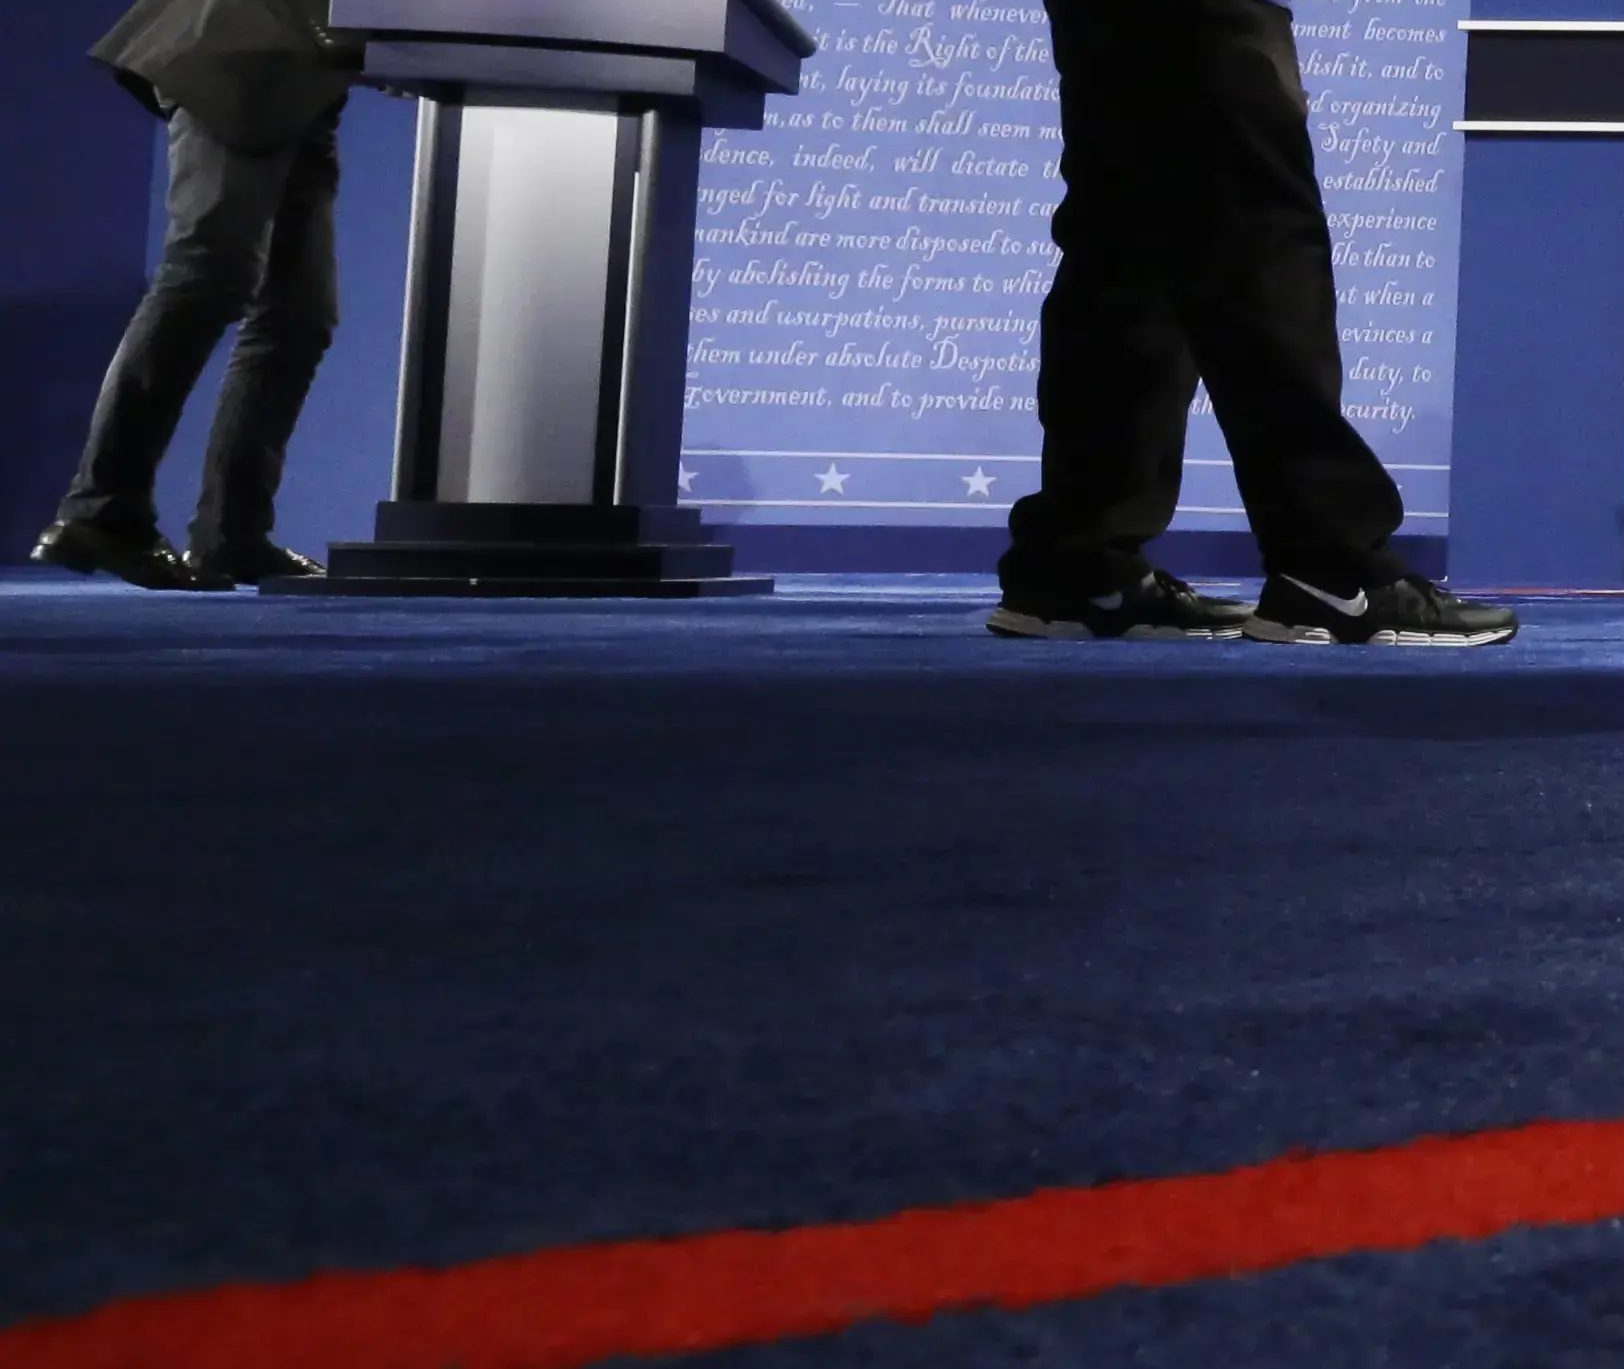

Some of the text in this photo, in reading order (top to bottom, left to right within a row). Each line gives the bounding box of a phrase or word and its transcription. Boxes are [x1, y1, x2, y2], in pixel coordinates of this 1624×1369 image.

[792, 142, 1445, 193] indeed, will dictate established
[692, 257, 1435, 307] by abolishing the forms to when a
[726, 299, 1416, 346] and usurpations, pursuing evinces
